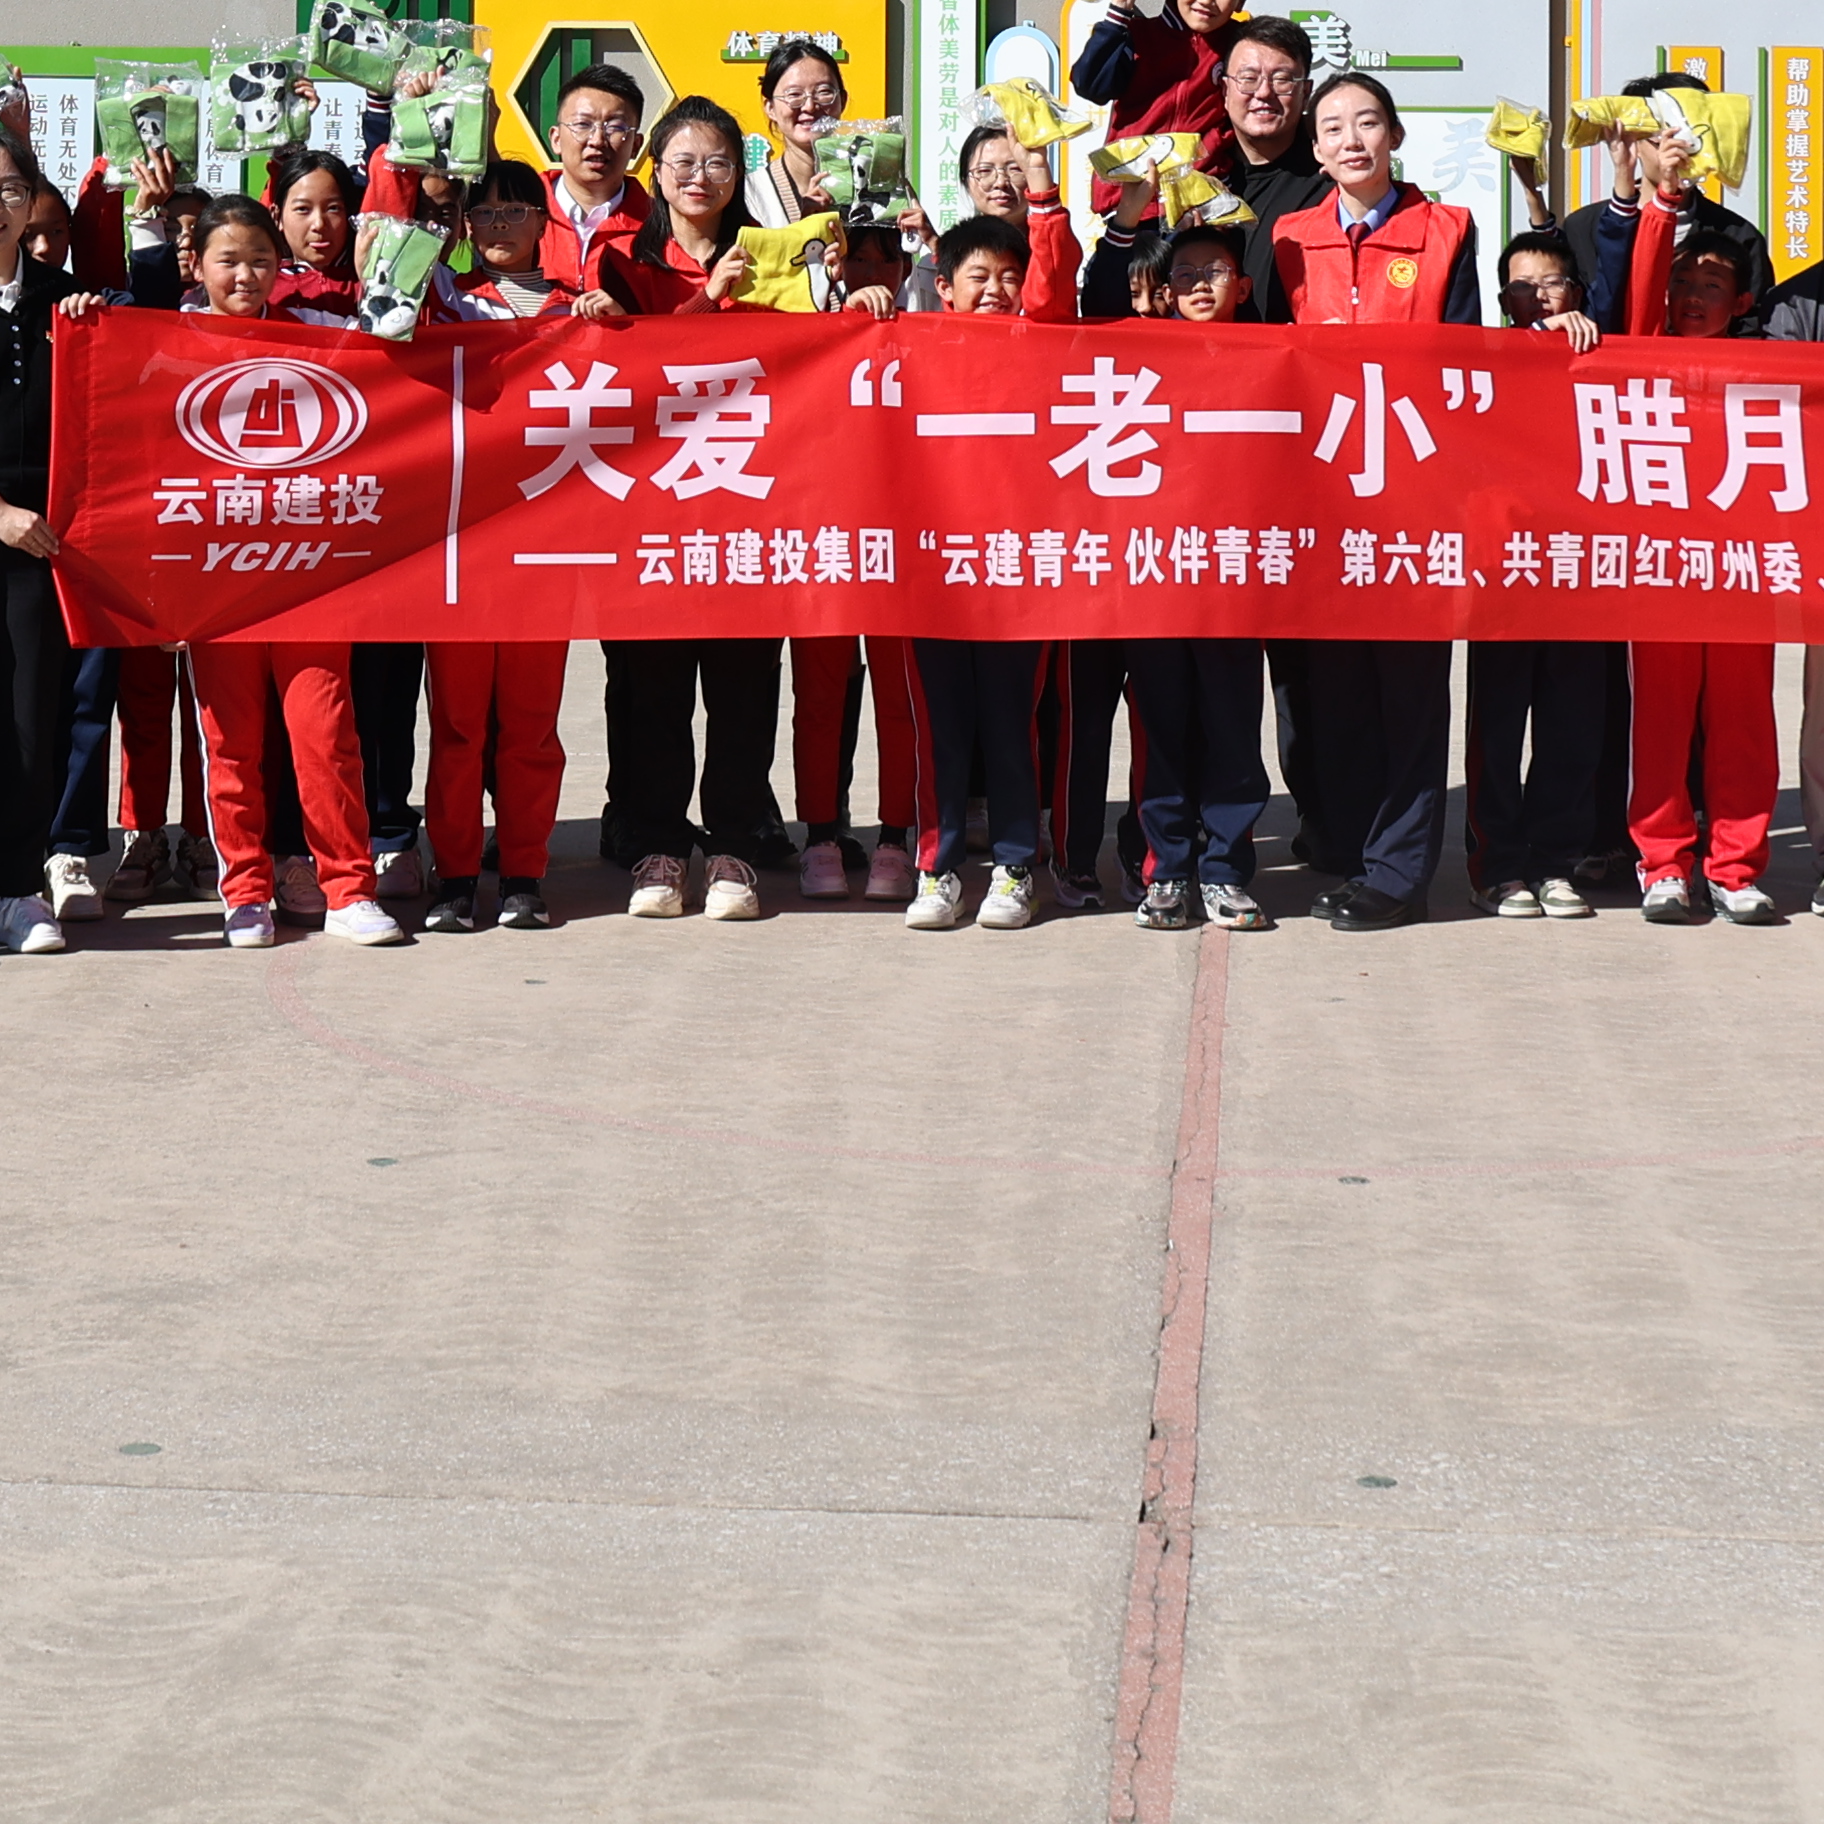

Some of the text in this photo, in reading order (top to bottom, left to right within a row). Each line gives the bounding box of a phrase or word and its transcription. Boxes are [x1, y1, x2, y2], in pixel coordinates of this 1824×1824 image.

[1300, 15, 1349, 68] 美
[1355, 49, 1388, 68] Mei
[1784, 57, 1811, 260] 帮助掌握艺术特长
[153, 473, 384, 526] 云南建投
[201, 541, 332, 572] YCIH
